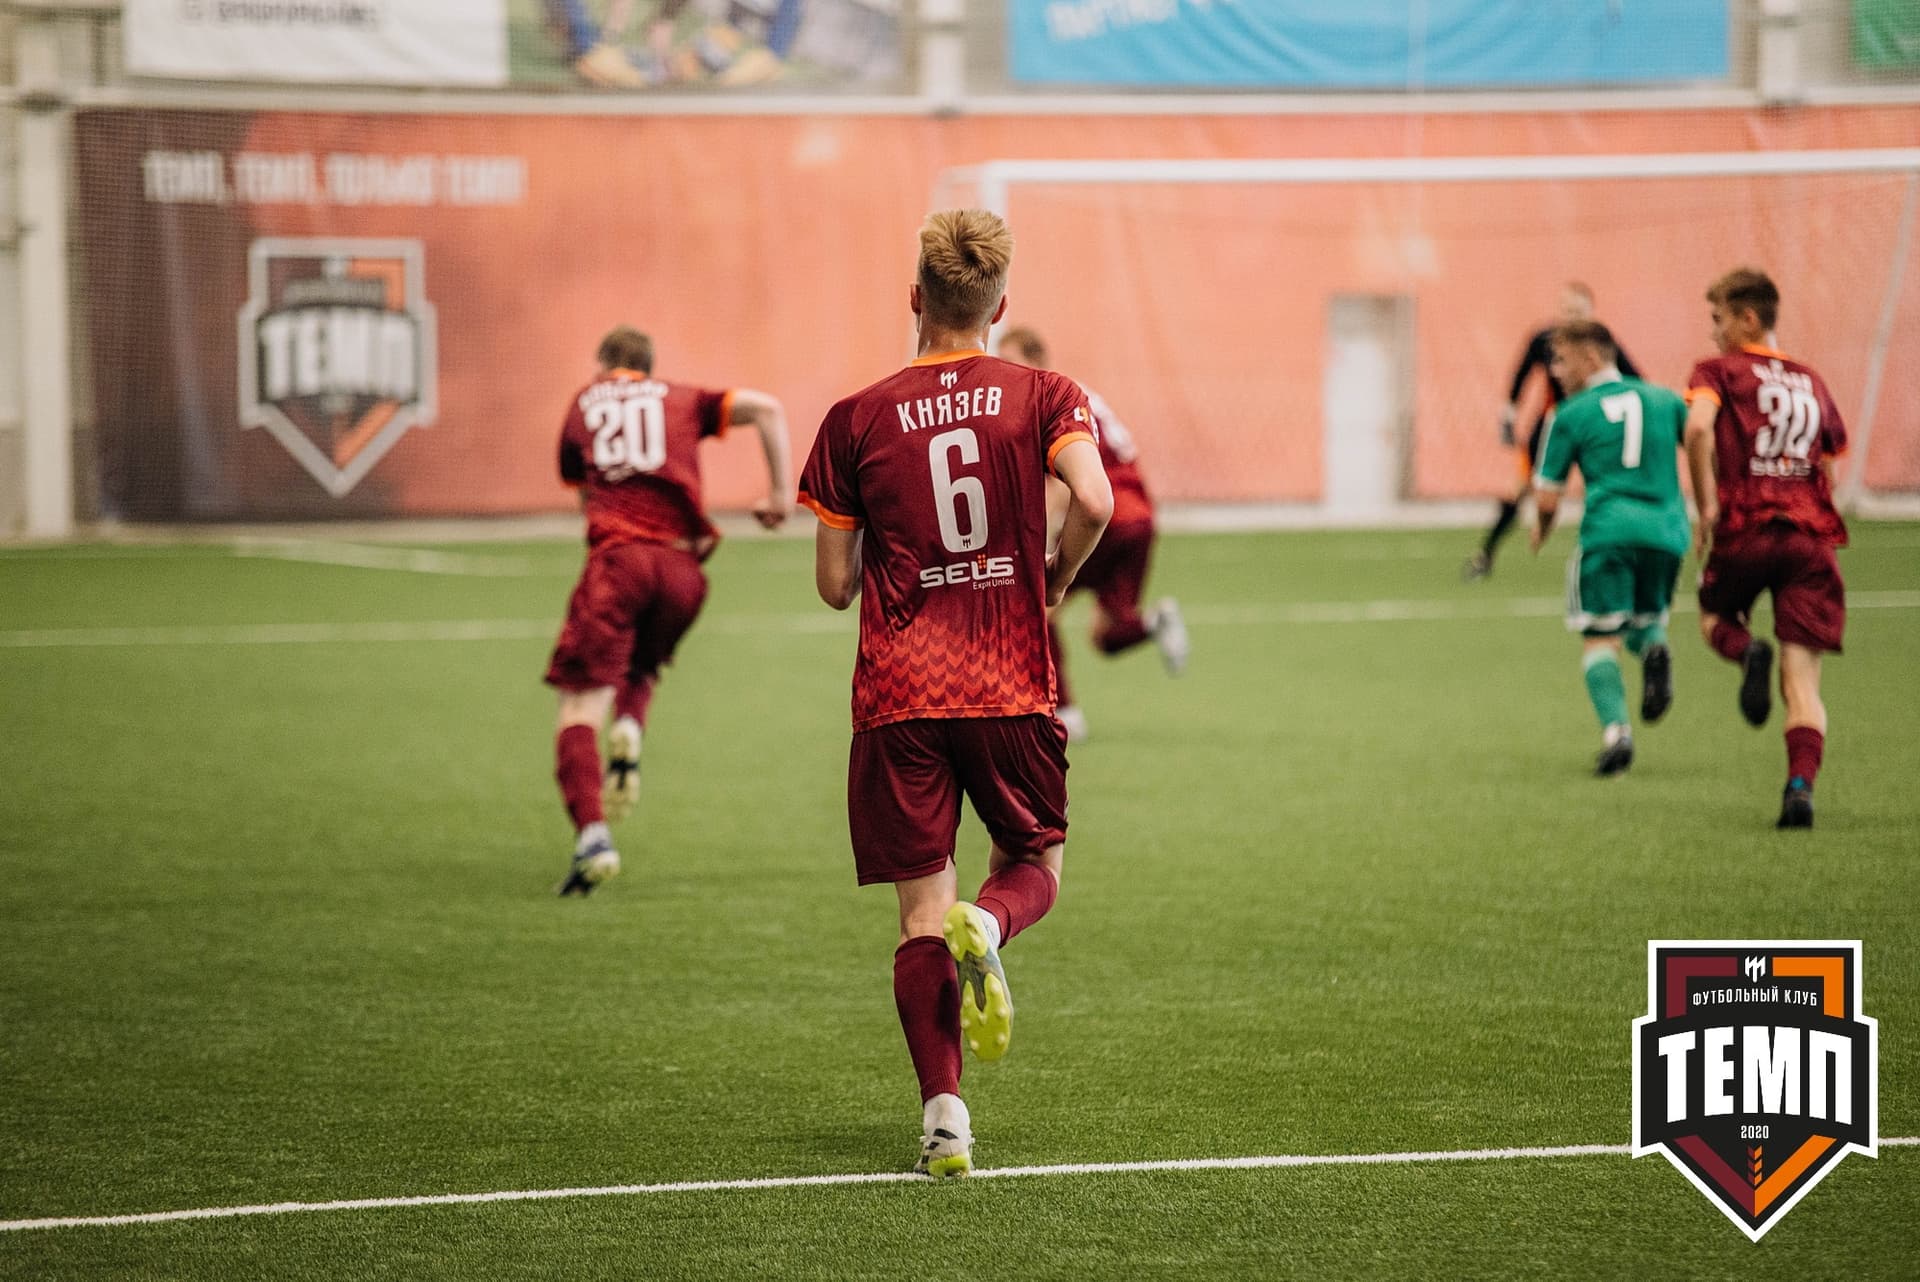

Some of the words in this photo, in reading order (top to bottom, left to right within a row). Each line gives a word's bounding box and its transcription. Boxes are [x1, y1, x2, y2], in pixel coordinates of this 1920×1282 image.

[584, 397, 667, 472] 20
[896, 386, 1003, 433] КНЯЗЕВ
[1600, 389, 1643, 469] 7
[1754, 383, 1820, 460] 30
[929, 427, 989, 553] 6
